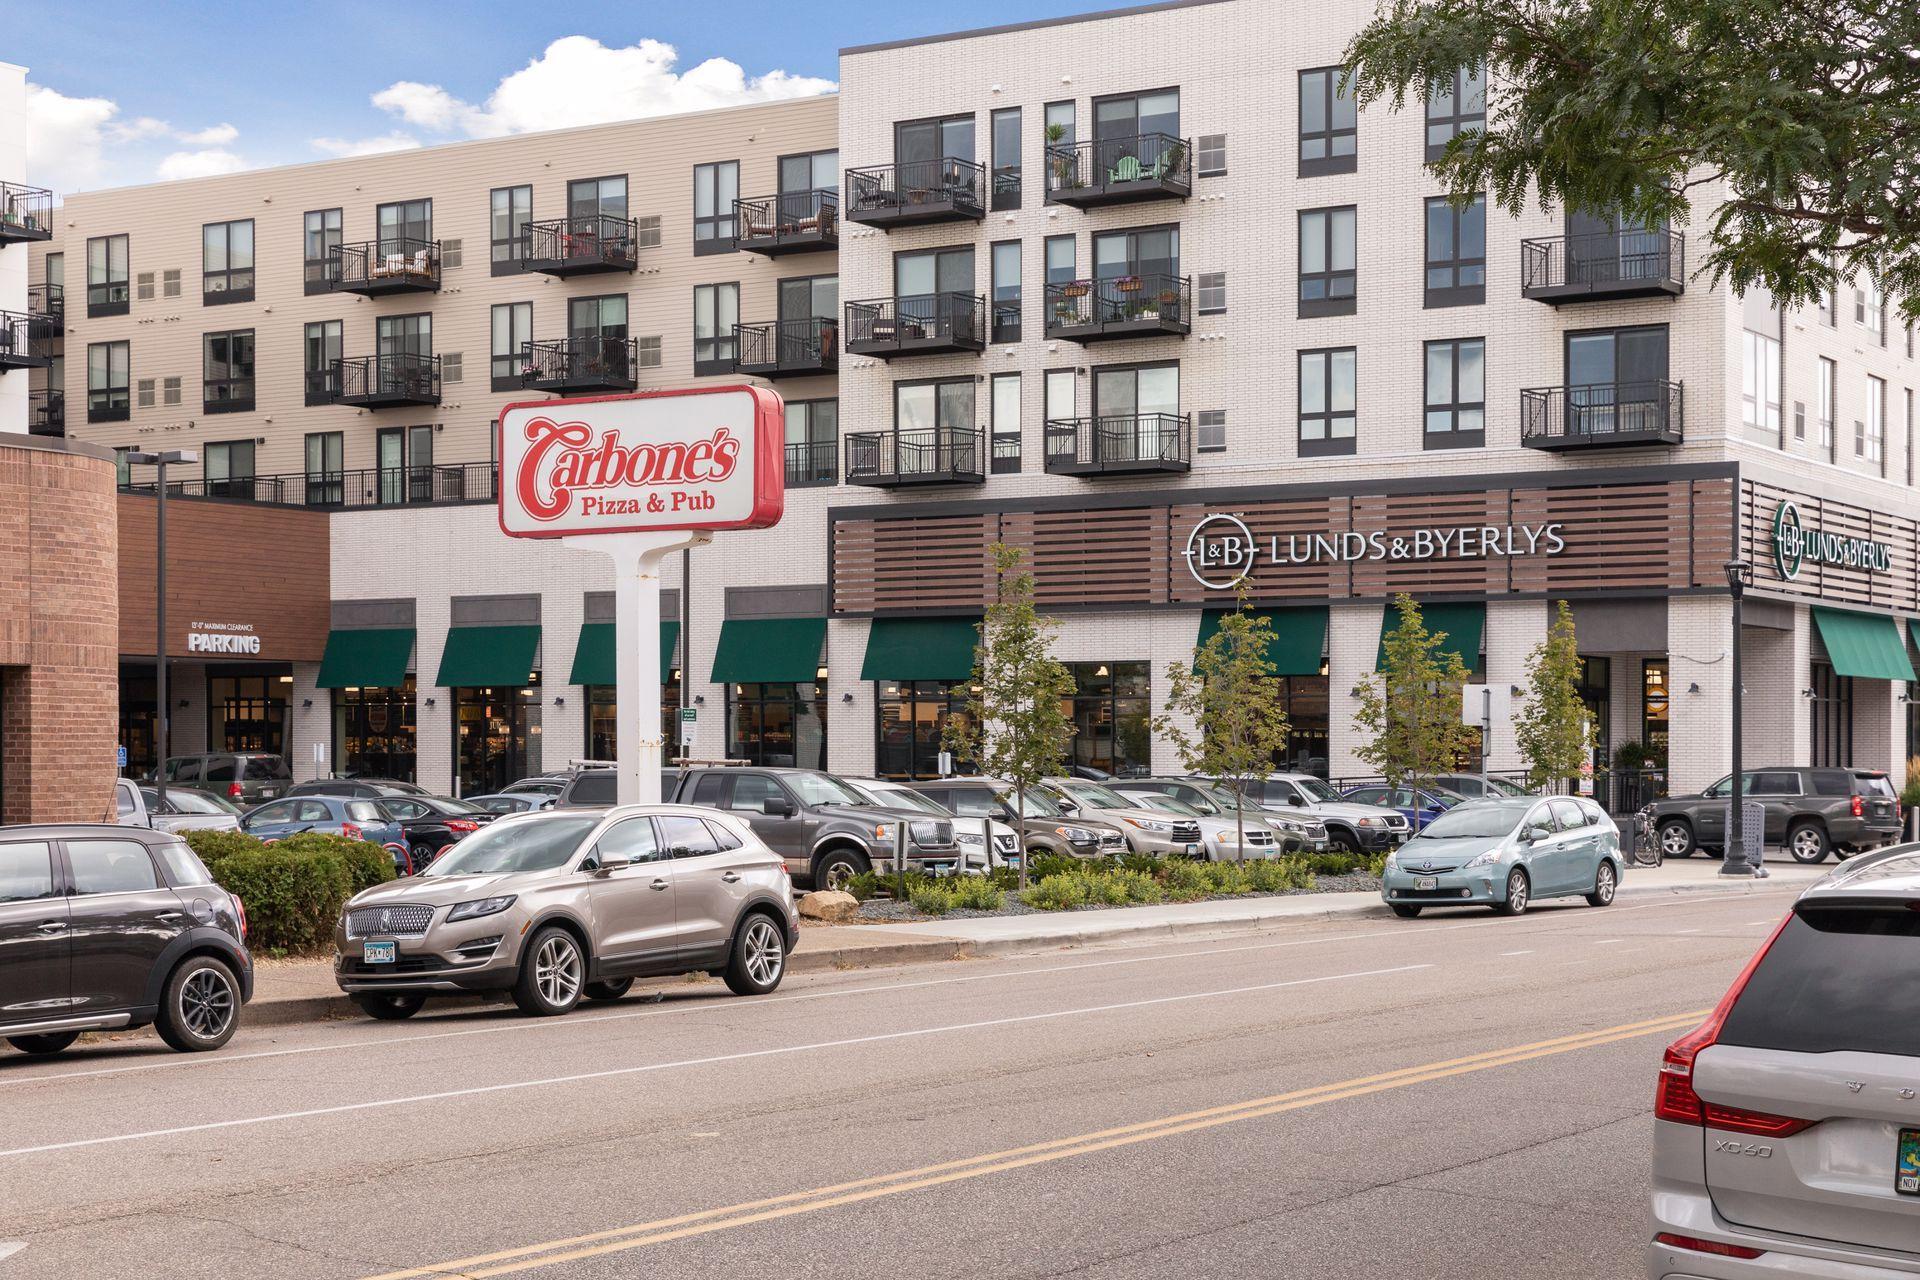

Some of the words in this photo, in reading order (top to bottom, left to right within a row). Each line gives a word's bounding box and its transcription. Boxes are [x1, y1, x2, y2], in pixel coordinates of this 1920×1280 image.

[517, 416, 740, 521] Carbone's
[581, 496, 640, 516] Pizza
[646, 493, 665, 514] &
[671, 491, 716, 512] Pub
[1199, 536, 1243, 567] L&B
[188, 633, 260, 654] PARKING
[1715, 1139, 1773, 1159] XC60
[1903, 1178, 1917, 1189] NOV
